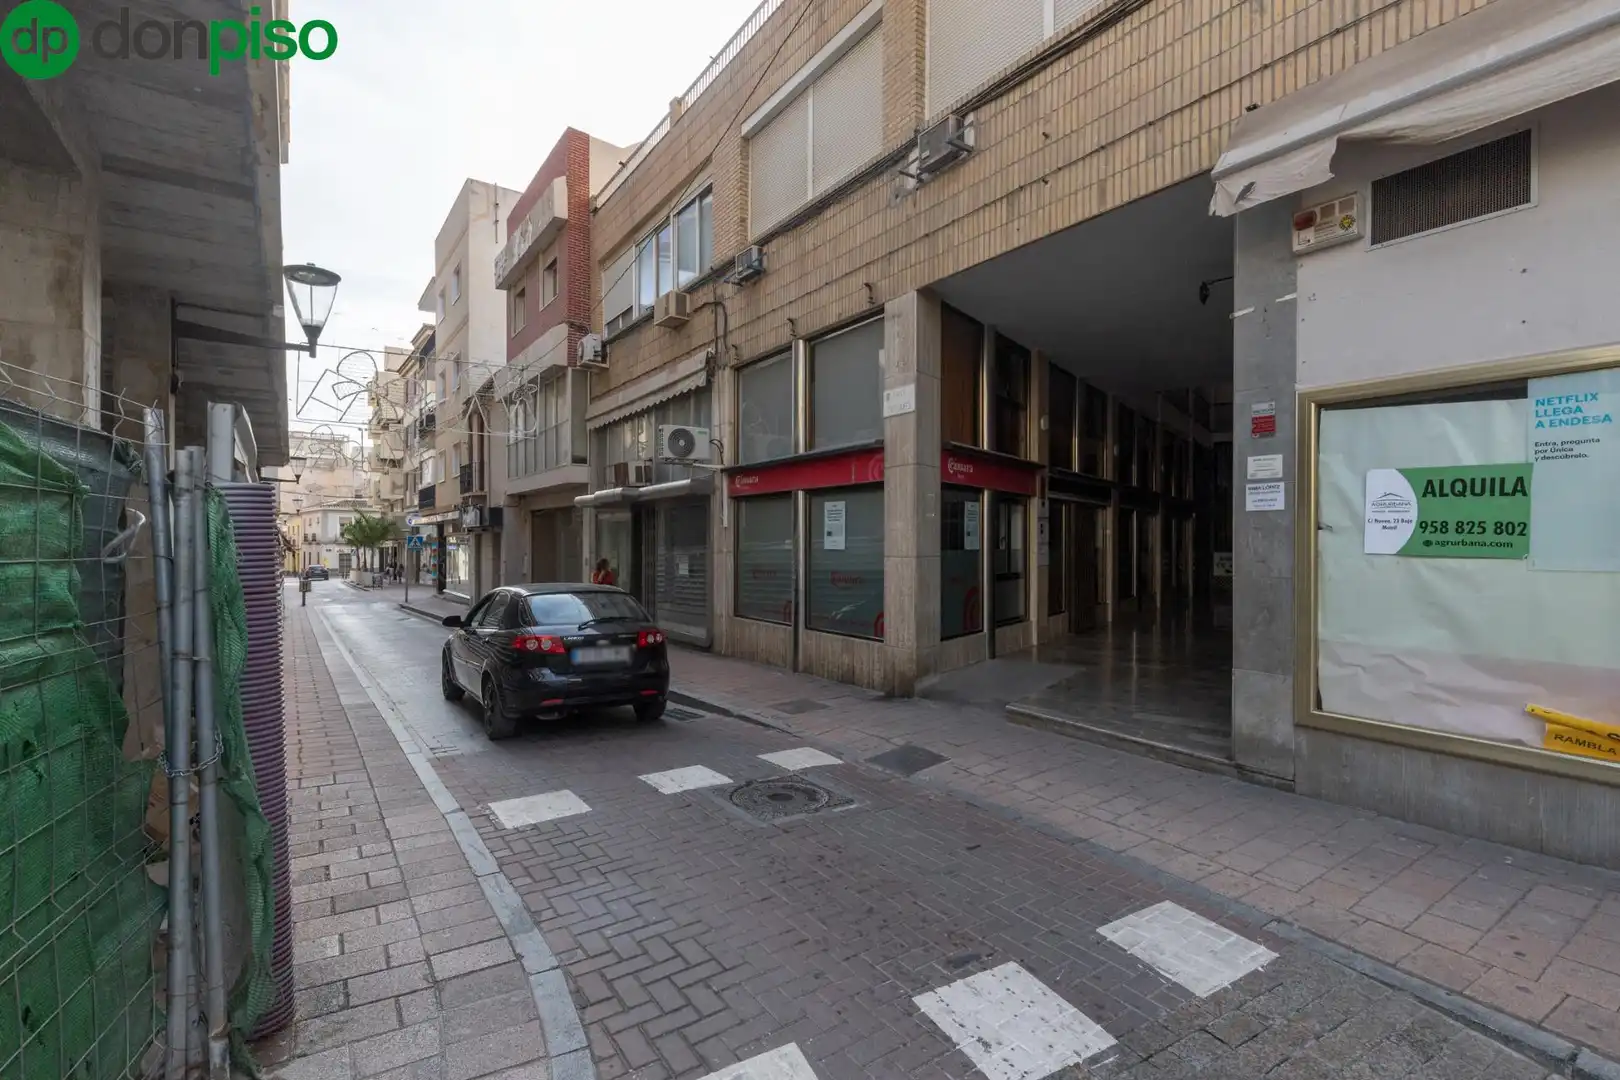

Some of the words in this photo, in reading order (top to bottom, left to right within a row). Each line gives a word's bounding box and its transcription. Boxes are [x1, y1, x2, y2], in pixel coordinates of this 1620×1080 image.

[1535, 392, 1598, 406] NETFLIX
[1535, 405, 1584, 418] LLEGA
[1535, 419, 1546, 429] A
[1549, 414, 1612, 427] ENDESA
[1534, 440, 1559, 448] Entra,
[1560, 437, 1601, 447] pregunta
[1421, 476, 1528, 498] ALQUILA
[1419, 520, 1449, 535] 958
[1455, 520, 1487, 535] 825
[1493, 521, 1528, 537] 802
[1434, 538, 1514, 549] agrurbana.com
[1554, 734, 1617, 755] RAMBLA
